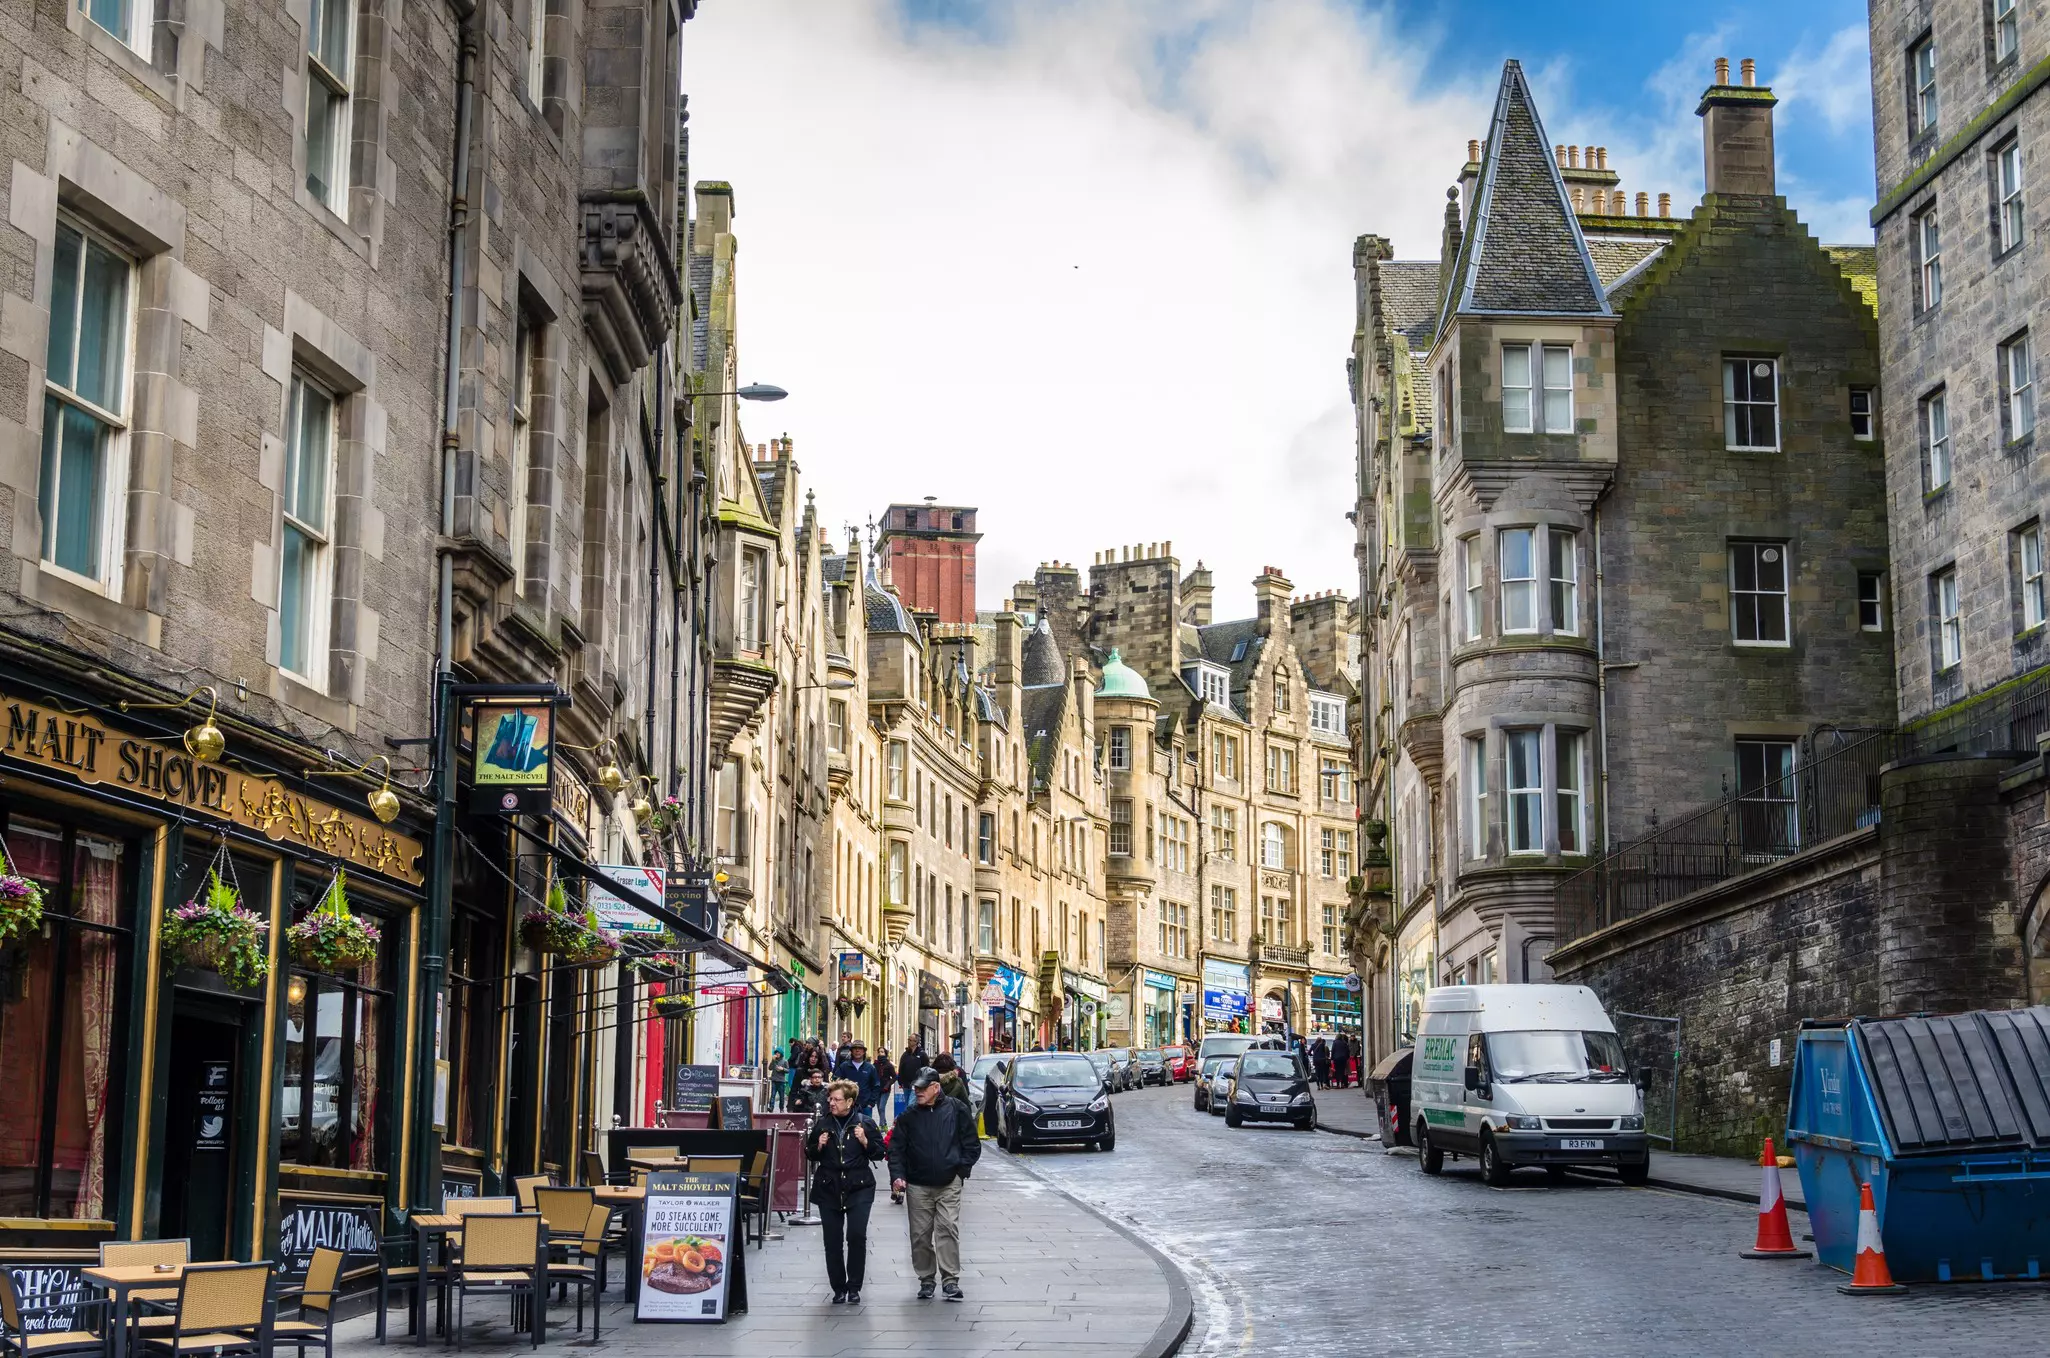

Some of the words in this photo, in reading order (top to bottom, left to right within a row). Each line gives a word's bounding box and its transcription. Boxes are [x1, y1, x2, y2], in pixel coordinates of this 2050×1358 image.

[4, 703, 106, 773] MALT
[117, 739, 235, 816] SHOVEL
[617, 876, 634, 886] Fraser
[635, 877, 649, 888] Legal
[647, 870, 656, 880] FOR
[653, 878, 662, 889] SALE
[681, 890, 702, 899] vino
[1423, 1037, 1458, 1061] BREMAC
[200, 1095, 226, 1105] Follow
[214, 1103, 225, 1111] us
[1568, 1140, 1579, 1148] R3
[1580, 1140, 1596, 1148] FYN
[652, 1183, 677, 1191] MALT
[678, 1183, 713, 1191] SHOVEL
[715, 1183, 731, 1191] INN
[655, 1211, 666, 1221] DO
[668, 1211, 697, 1221] STEAKS
[700, 1212, 720, 1222] COME
[293, 1209, 352, 1251] MALT
[651, 1221, 671, 1231] MORE
[674, 1222, 723, 1232] SUCCULENT?
[47, 1314, 73, 1333] today
